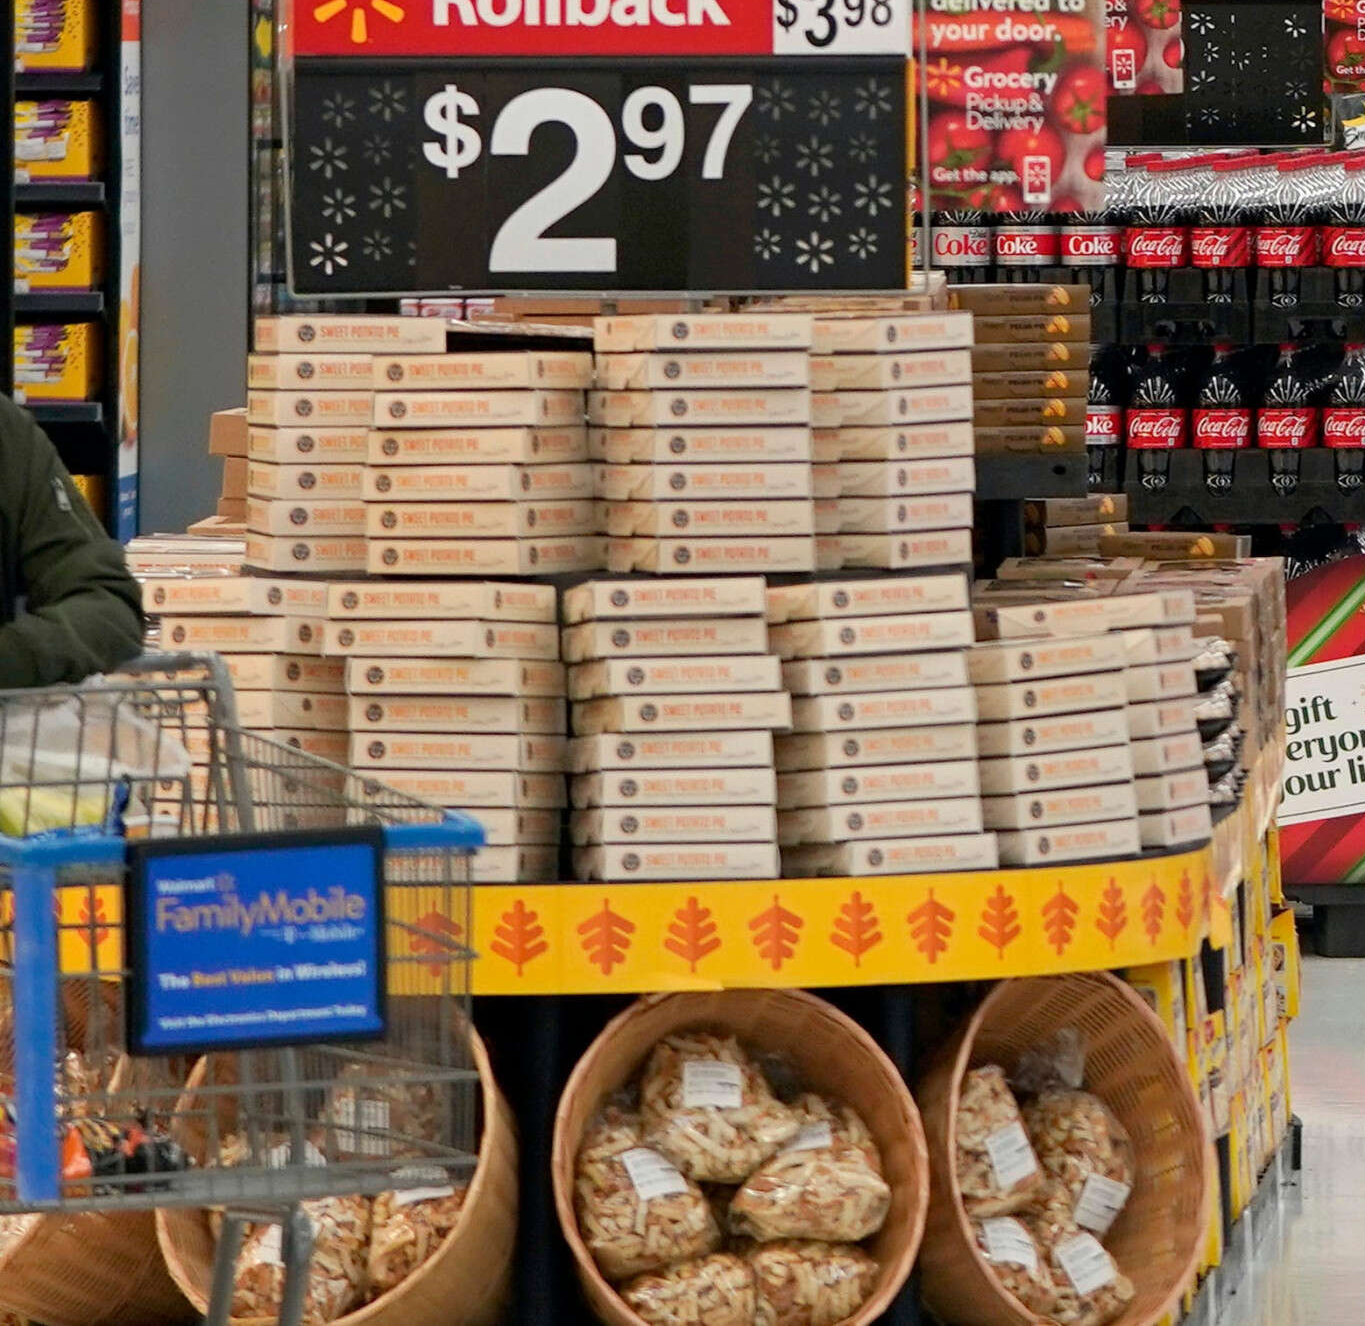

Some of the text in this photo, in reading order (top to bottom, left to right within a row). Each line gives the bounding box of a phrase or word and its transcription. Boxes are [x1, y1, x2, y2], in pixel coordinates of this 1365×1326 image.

[930, 14, 1063, 45] your door.
[963, 66, 1058, 93] Grocery
[1336, 65, 1354, 76] Get
[965, 112, 1045, 136] Delivery
[422, 83, 753, 274] $297
[932, 167, 960, 182] Get
[962, 167, 987, 182] the
[934, 231, 987, 257] Coke
[996, 234, 1038, 256] Coke
[1068, 235, 1114, 256] Coke
[1285, 695, 1338, 735] gift
[156, 886, 366, 936] FamilyMobile
[159, 973, 190, 991] The
[192, 971, 228, 988] Best
[277, 967, 291, 983] in
